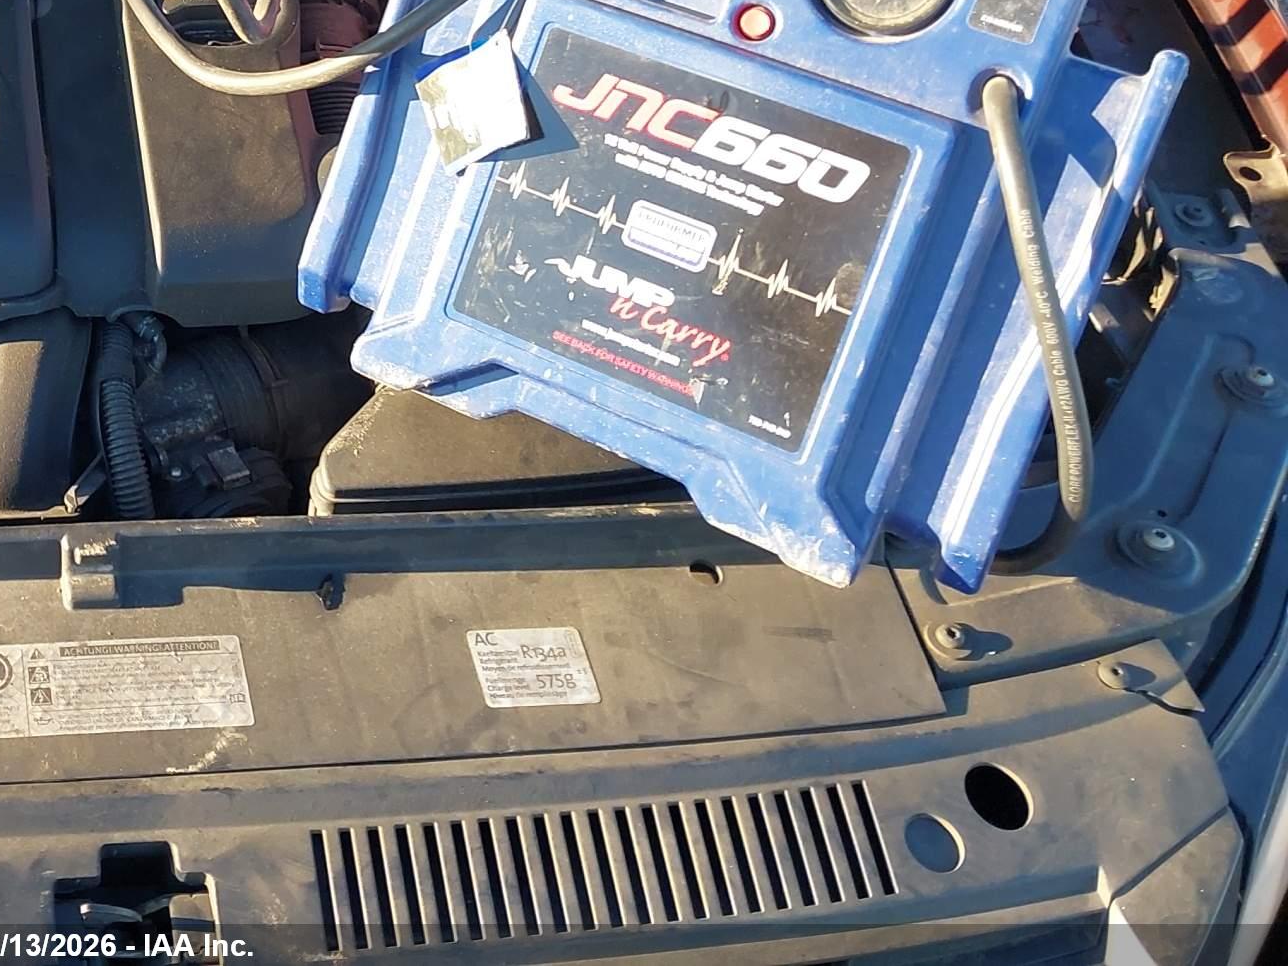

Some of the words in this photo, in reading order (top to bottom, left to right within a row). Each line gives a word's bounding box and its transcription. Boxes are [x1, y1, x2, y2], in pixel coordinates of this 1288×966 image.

[1020, 208, 1034, 239] Cable
[1029, 243, 1044, 286] Welding
[545, 254, 675, 308] JUMP
[640, 305, 731, 368] Carry
[1044, 321, 1059, 345] 600V
[1050, 349, 1065, 377] Cable
[475, 632, 499, 646] AC
[520, 644, 567, 662] R134a
